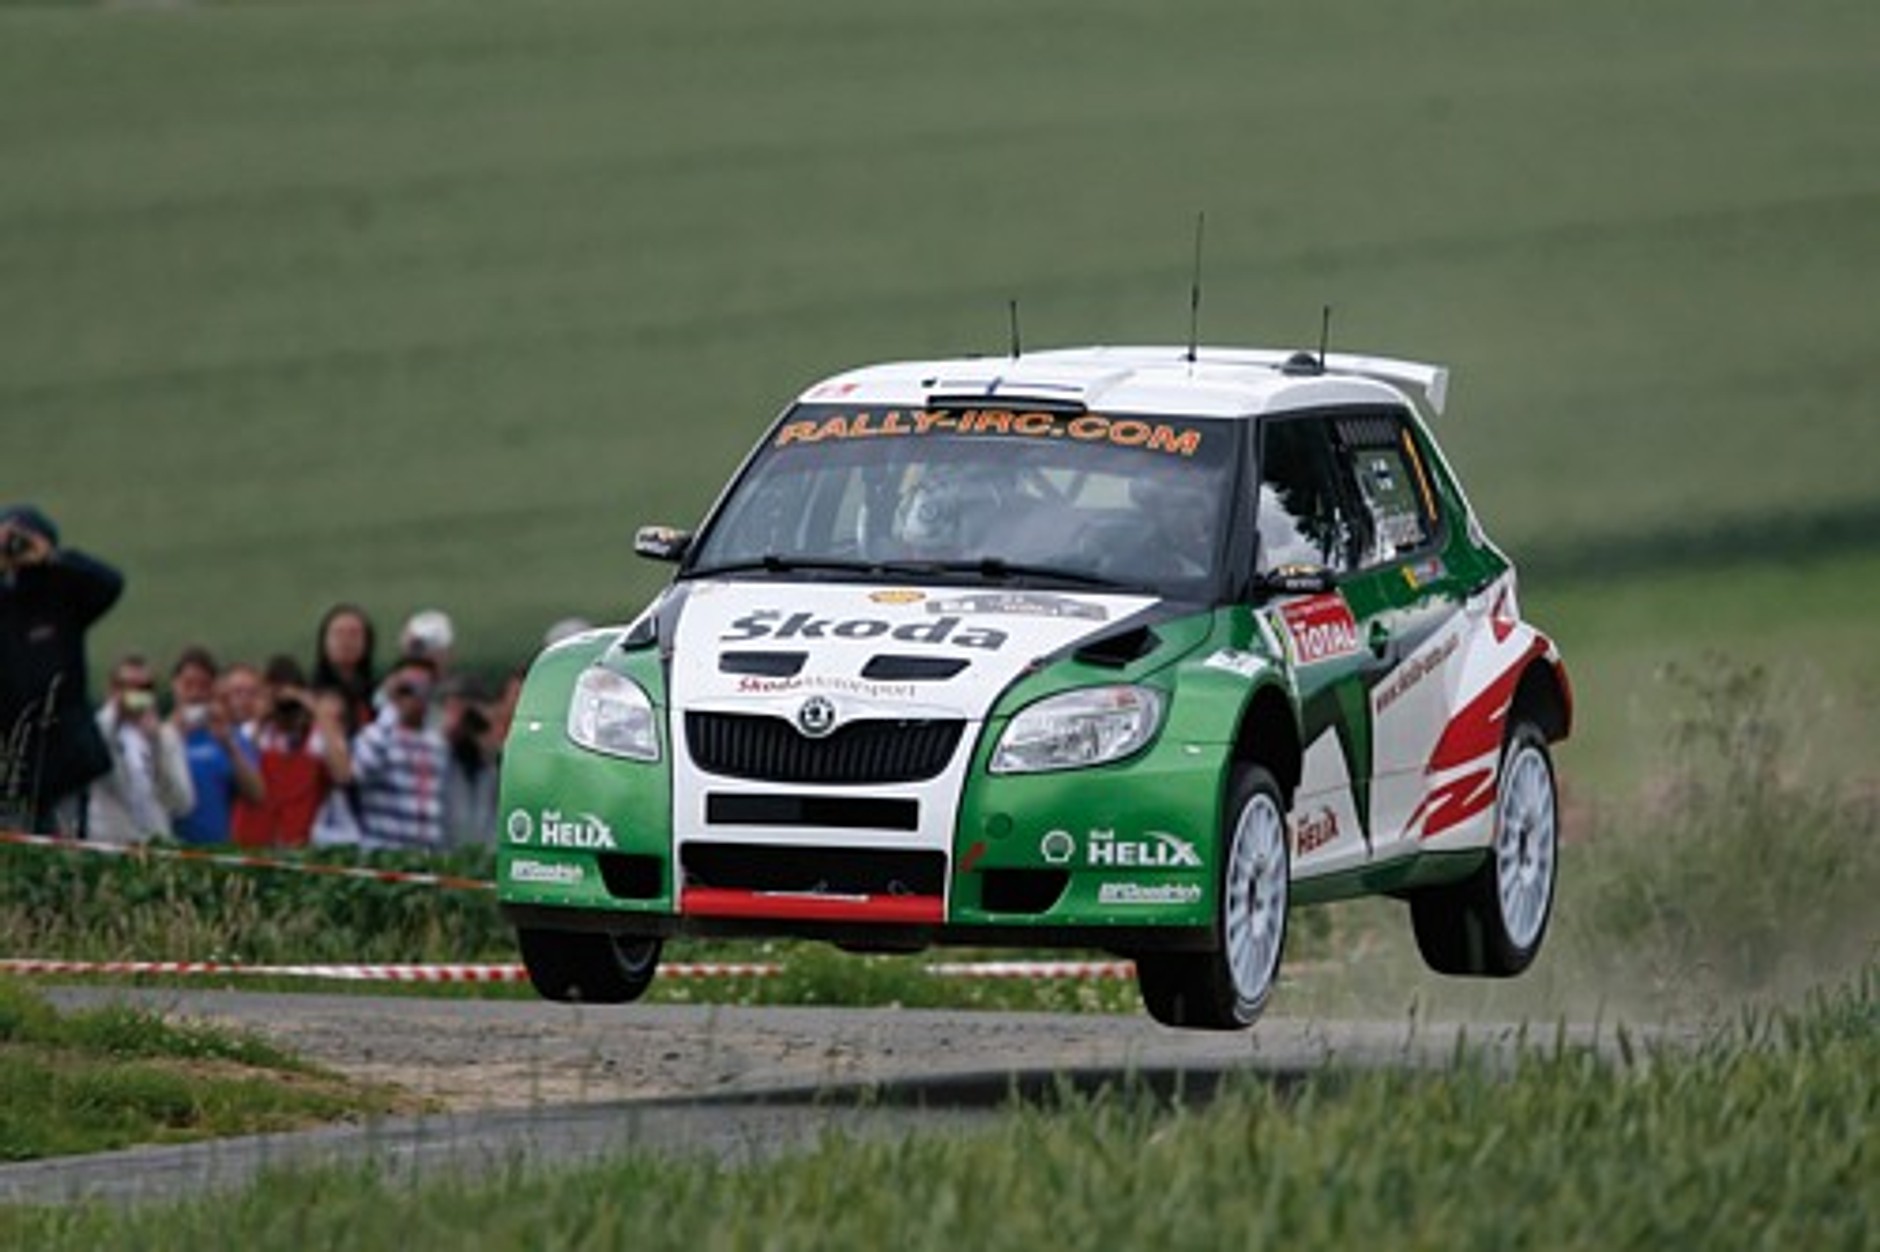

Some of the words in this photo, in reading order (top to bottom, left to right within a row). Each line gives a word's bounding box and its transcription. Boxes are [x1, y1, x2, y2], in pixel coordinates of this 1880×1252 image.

[776, 410, 1201, 454] RALLY-IRC.COM
[719, 609, 1008, 650] Škoda
[1292, 620, 1357, 659] TOTAL
[541, 812, 616, 848] HELIX
[1088, 831, 1202, 866] HELIX
[1297, 806, 1339, 857] HELIX
